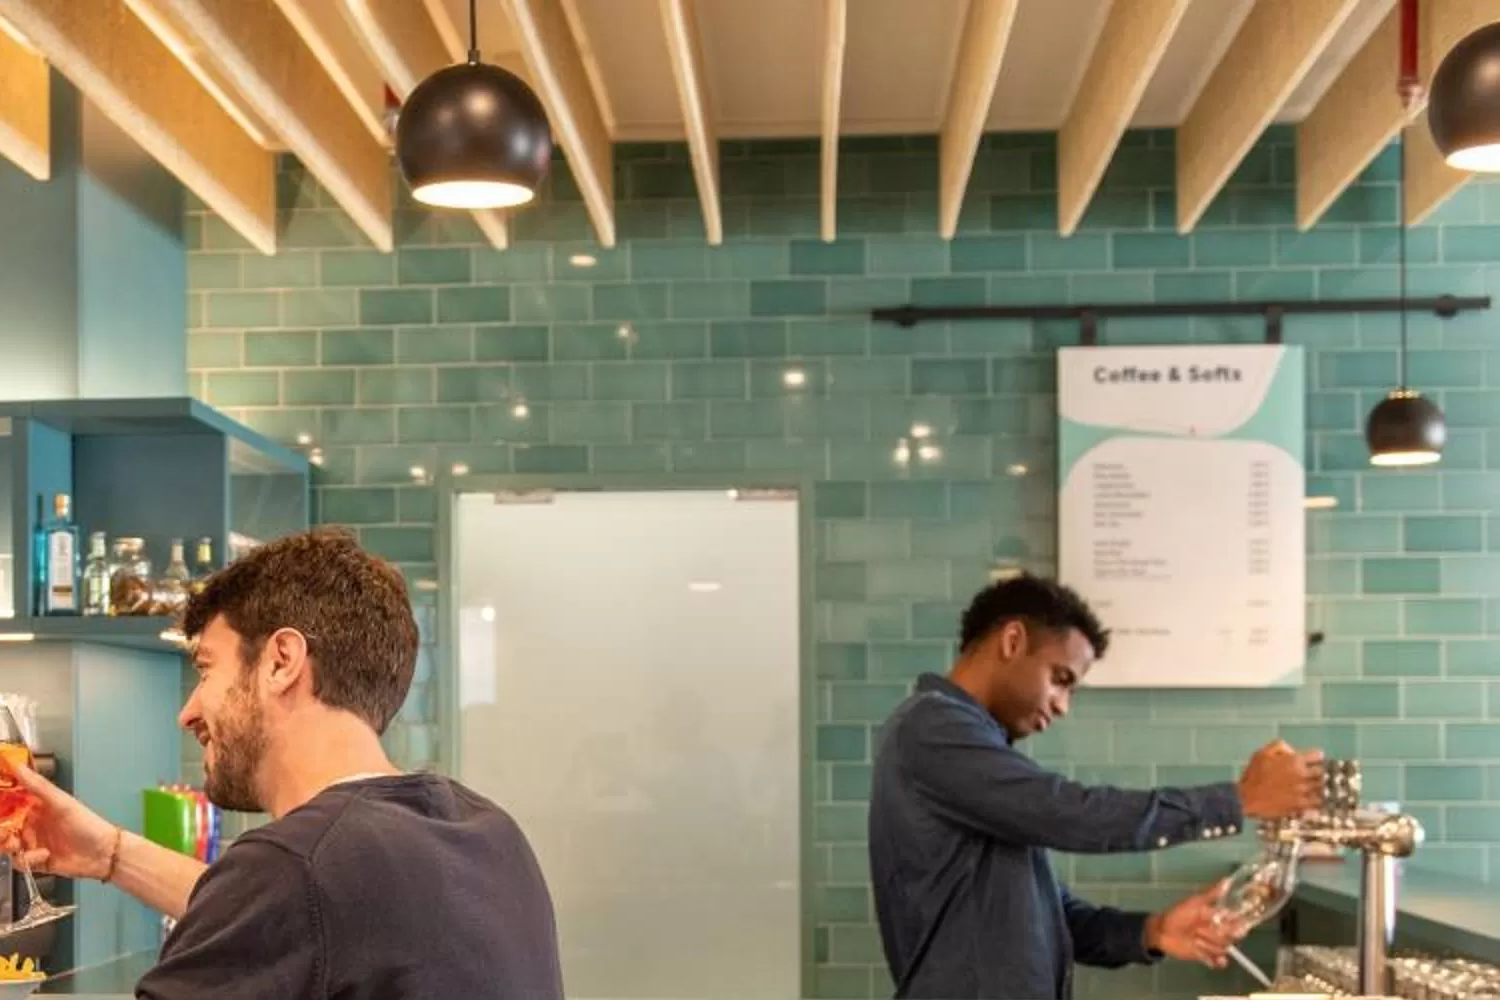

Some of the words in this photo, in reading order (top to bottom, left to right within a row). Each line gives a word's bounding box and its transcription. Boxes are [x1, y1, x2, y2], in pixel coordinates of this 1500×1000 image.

[1093, 365, 1161, 383] Coffee
[1169, 365, 1181, 382] &
[1188, 364, 1243, 383] Softs
